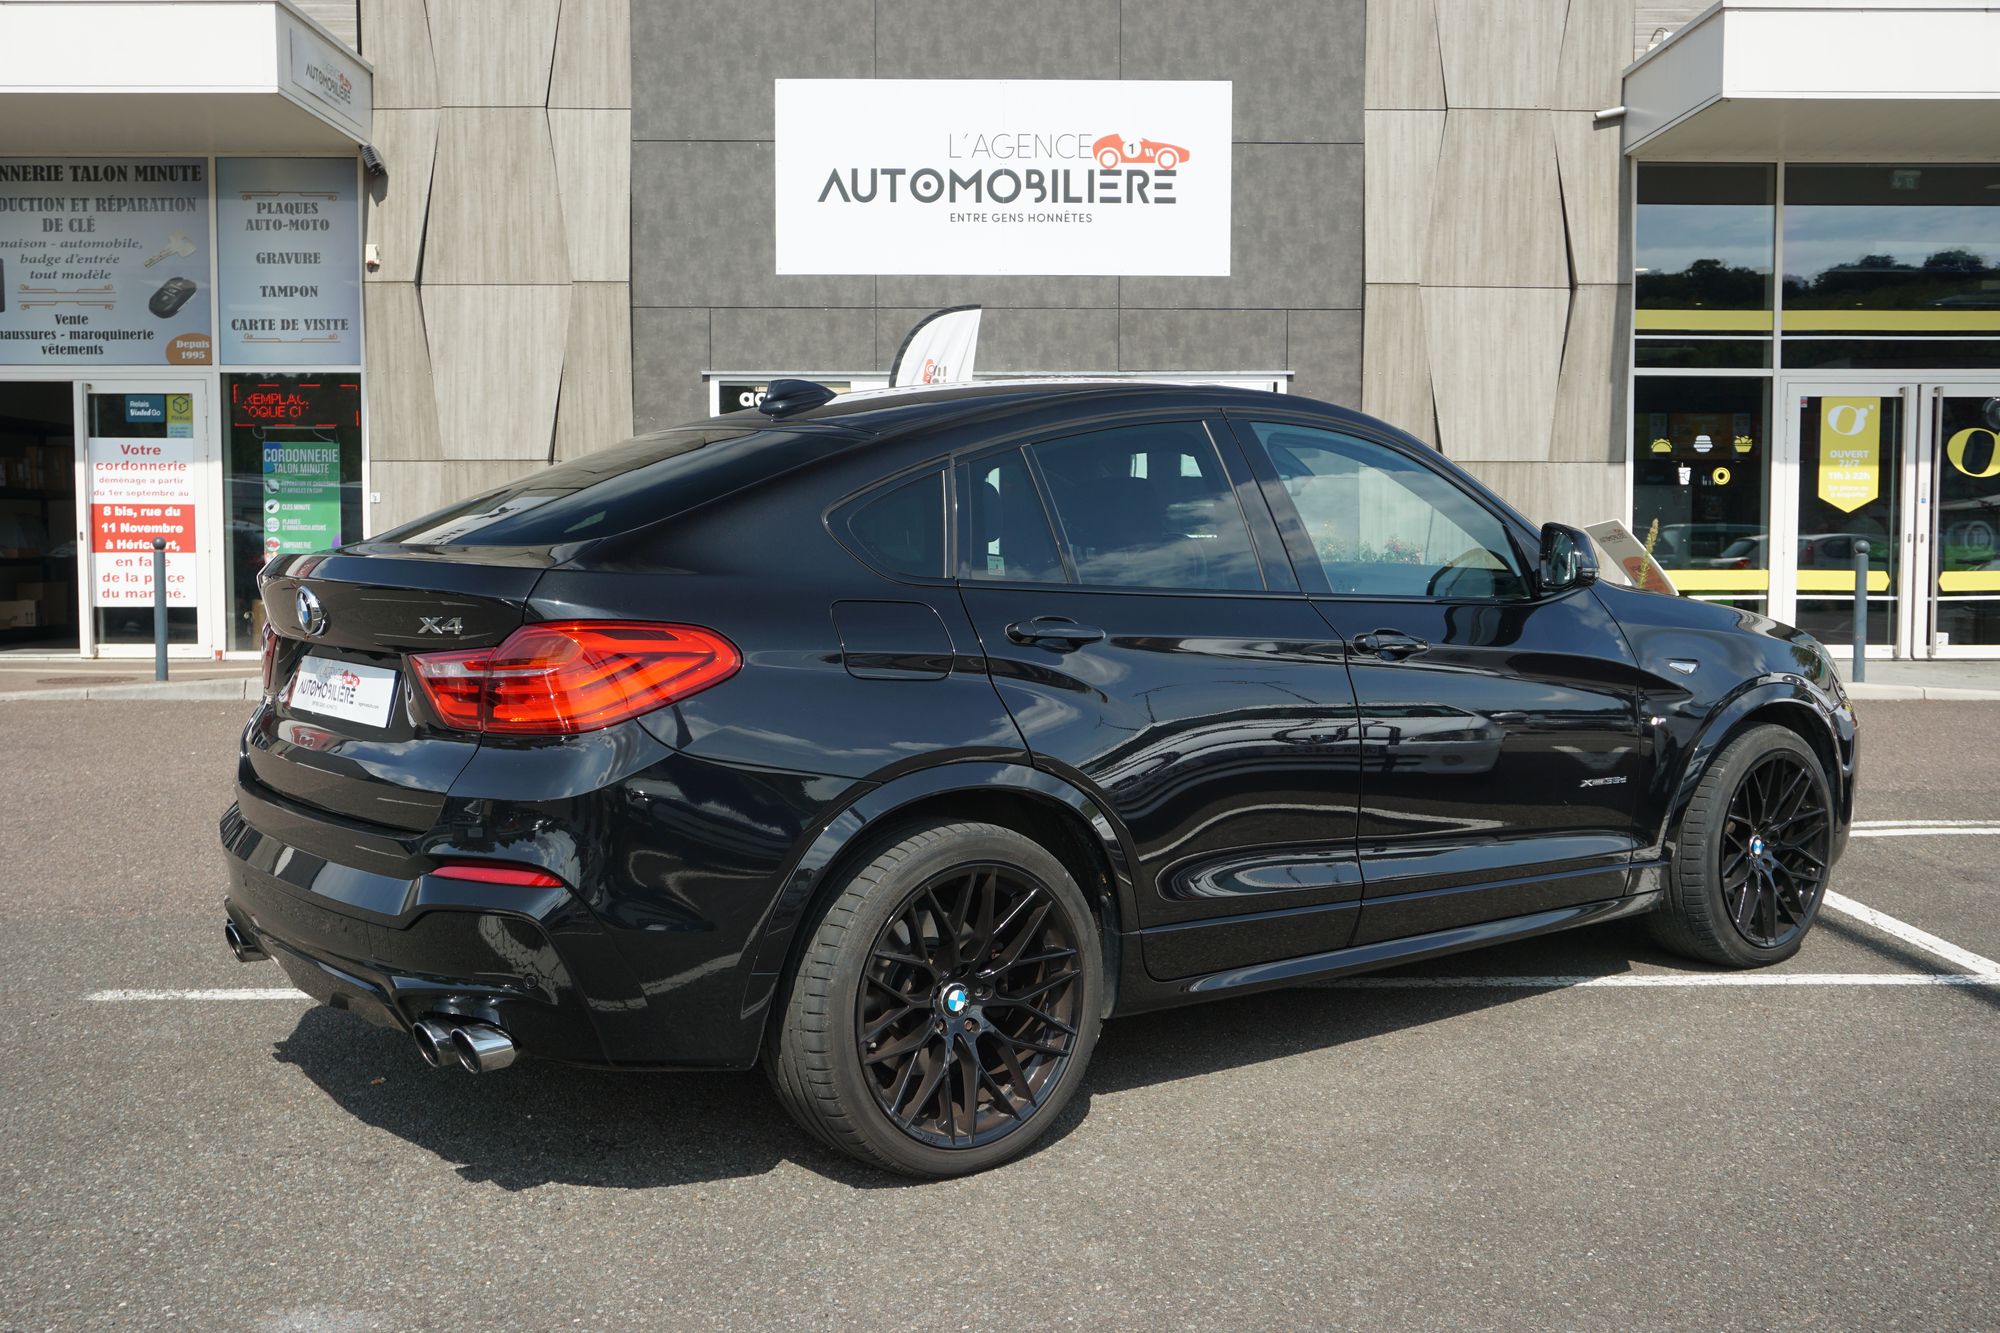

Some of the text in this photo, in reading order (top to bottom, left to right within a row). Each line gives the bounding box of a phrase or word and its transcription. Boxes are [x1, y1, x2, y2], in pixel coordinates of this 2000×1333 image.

[949, 133, 1093, 159] L'AGENCE
[69, 164, 129, 182] TALON
[134, 164, 202, 182] MINUTE
[71, 197, 90, 212] ET
[95, 194, 197, 213] RÉPARATION
[256, 202, 319, 215] PLAQUES
[950, 210, 1093, 223] ENTRE GENS HONNÊTES
[42, 215, 96, 233] DE CLÉ
[245, 219, 330, 231] AUTO-MOTO
[20, 253, 120, 266] badge d'entrée
[255, 252, 321, 264] GRAVURE
[30, 268, 112, 280] tout modèle
[259, 285, 319, 298] TAMPON
[55, 314, 89, 325] Vente
[231, 318, 349, 331] CARTE DE VISITE
[69, 329, 154, 343] maroquinerie
[41, 343, 104, 355] vêtements
[176, 340, 210, 350] Depuis
[181, 351, 206, 360] 1995
[120, 445, 162, 456] Votre
[264, 448, 338, 463] CORDONNERIE
[1829, 450, 1869, 458] OUVERT
[95, 461, 187, 472] cordonnerie
[273, 463, 330, 474] TALON MINUTE
[158, 477, 184, 485] partir
[126, 490, 175, 498] septembre
[103, 506, 181, 518] 8 bis, rue du
[101, 522, 184, 533] 11 Novembre
[105, 539, 114, 549] à
[115, 556, 171, 567] en fae
[102, 572, 185, 584] de la pce
[102, 588, 119, 598] du
[417, 617, 463, 635] X4
